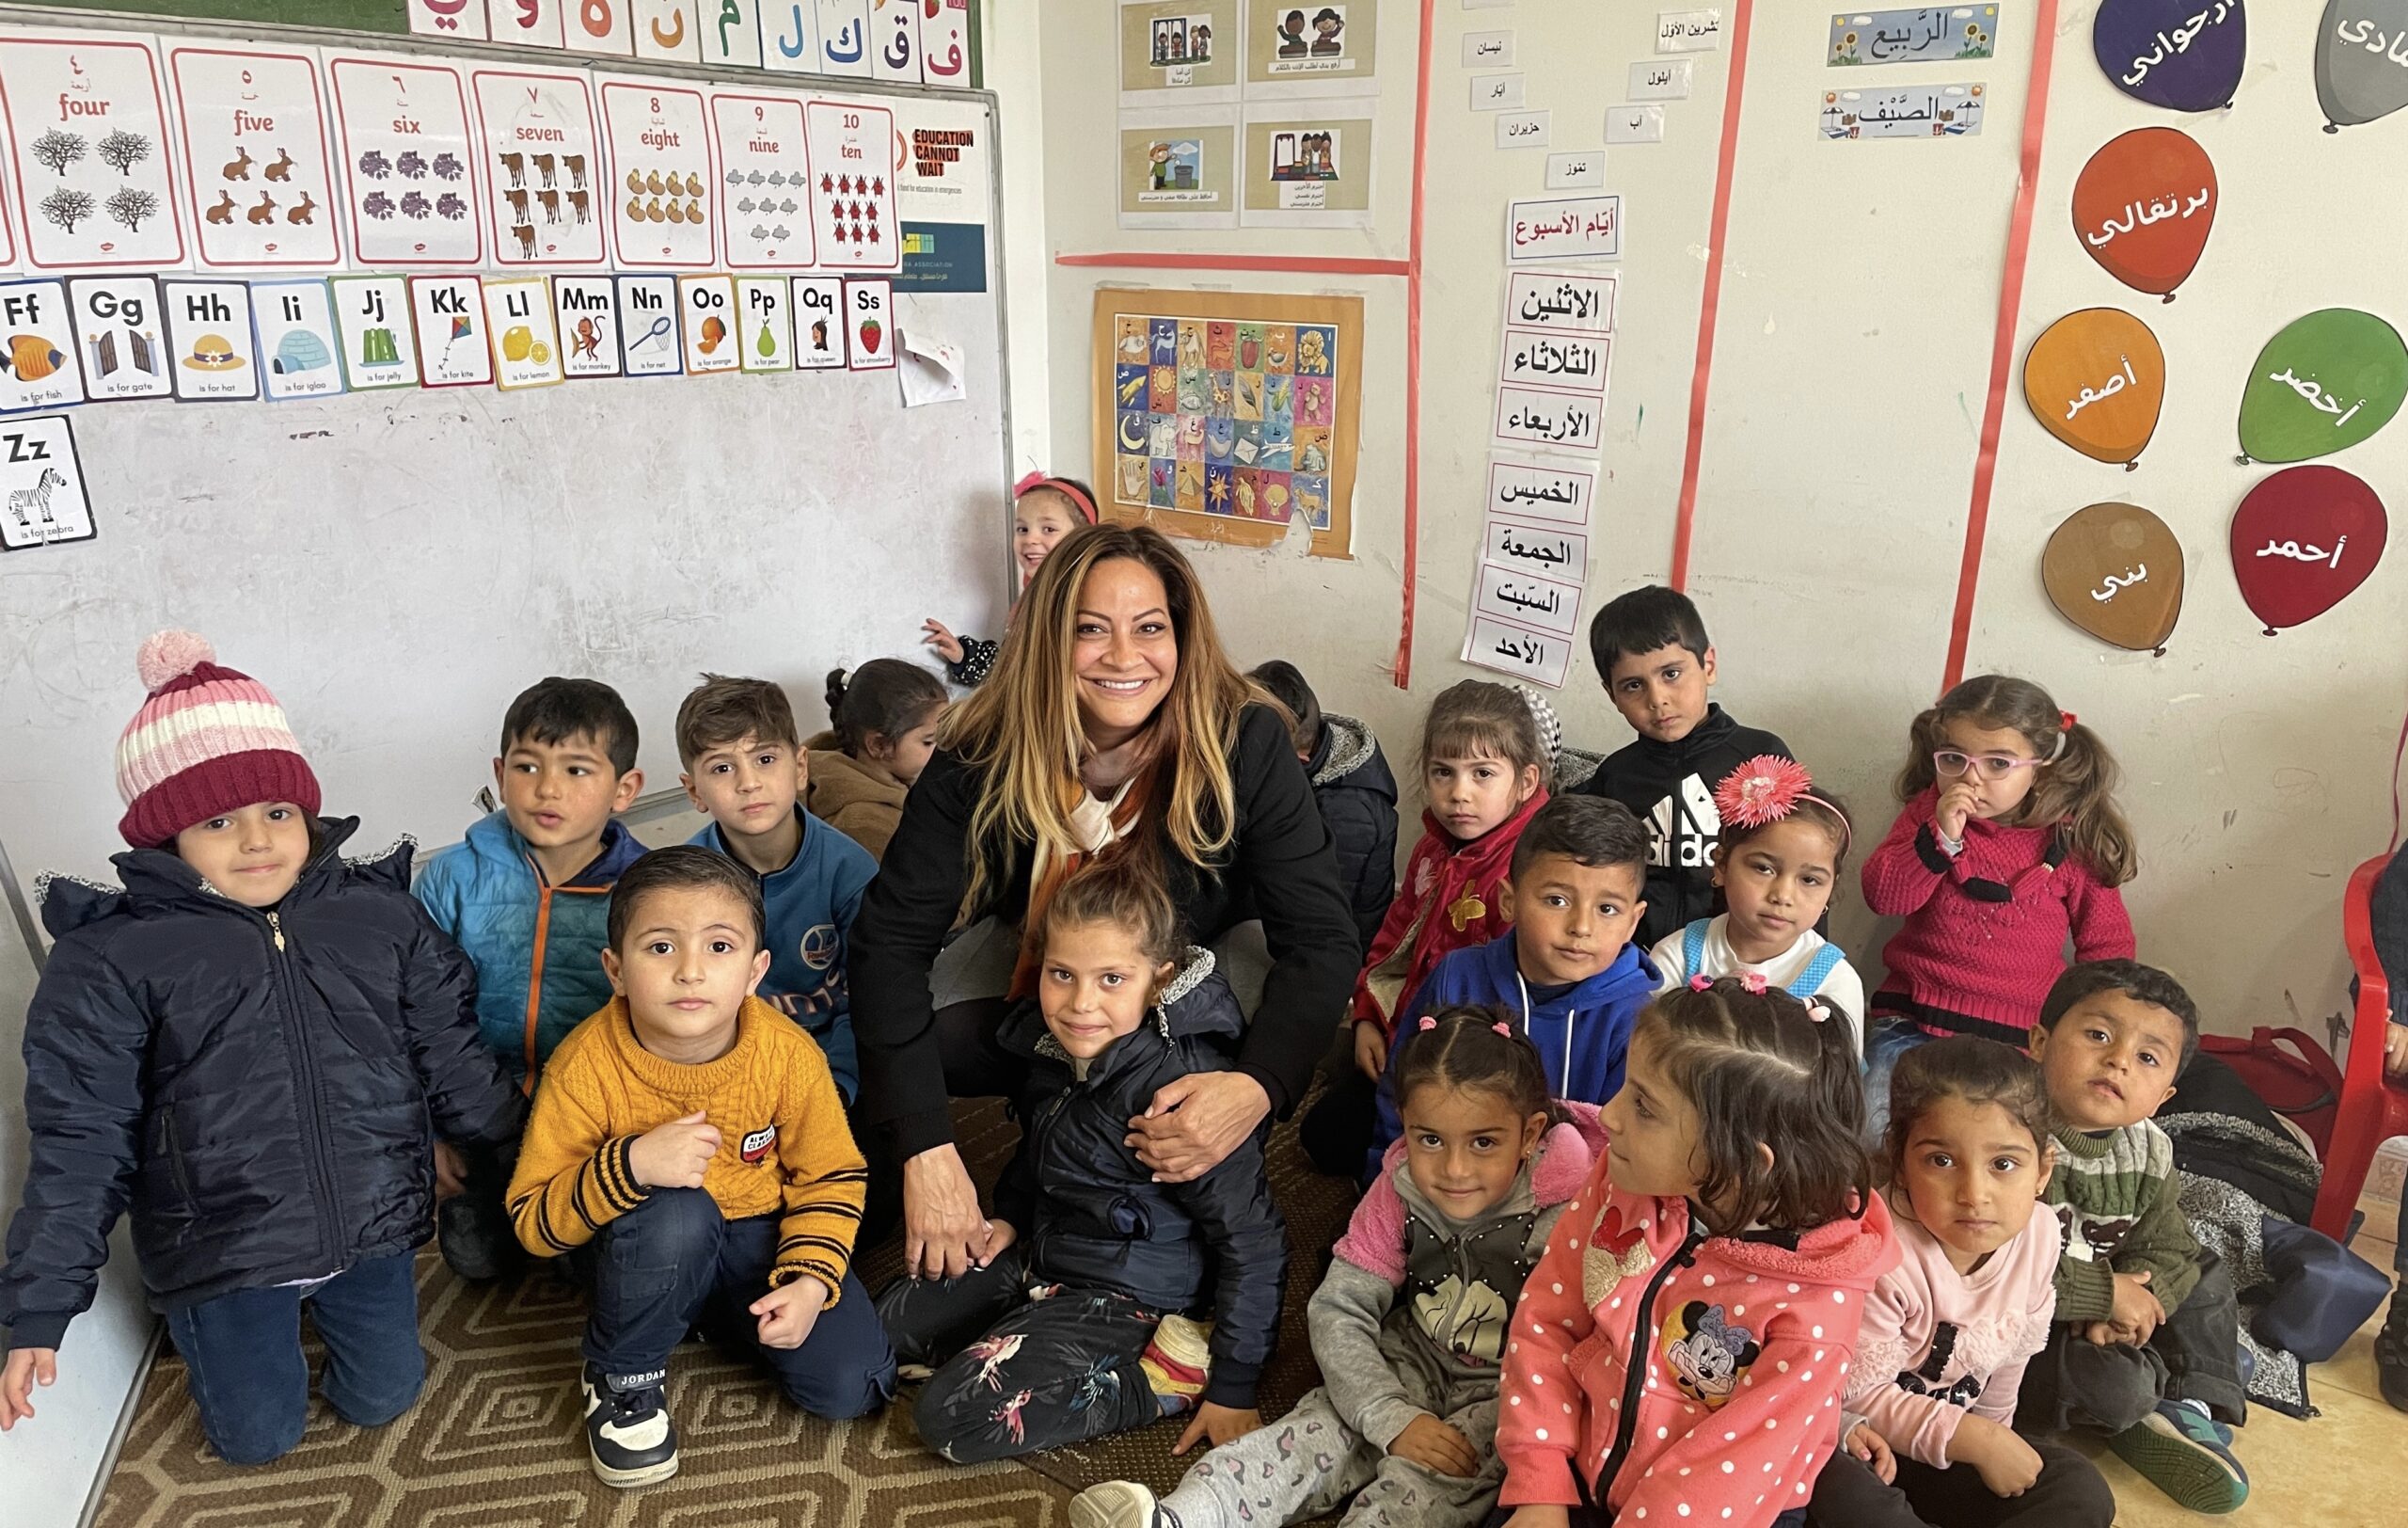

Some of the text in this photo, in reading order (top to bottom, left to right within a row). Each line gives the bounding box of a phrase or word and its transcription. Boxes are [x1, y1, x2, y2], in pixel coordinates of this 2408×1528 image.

[652, 0, 684, 48] ن
[719, 0, 741, 56] م
[780, 5, 803, 57] ل
[826, 18, 863, 63] ك
[884, 15, 910, 69] ق
[1478, 40, 1501, 55] نيسان
[928, 29, 962, 75] ف
[70, 55, 84, 75] ٤
[242, 71, 252, 84] ٥
[392, 76, 405, 93] ٦
[1648, 69, 1671, 86] أيلول
[527, 87, 538, 103] ٧
[651, 98, 660, 113] 8
[59, 93, 110, 121] four
[754, 107, 764, 121] 9
[234, 109, 274, 135] five
[392, 116, 421, 134] six
[843, 114, 860, 129] 10
[1509, 122, 1540, 135] حزيران
[516, 126, 564, 142] seven
[641, 130, 680, 151] eight
[913, 129, 974, 147] EDUCATION
[749, 138, 780, 153] nine
[841, 143, 862, 159] ten
[915, 145, 959, 162] CANNOT
[916, 162, 944, 177] WAIT
[1515, 210, 1579, 246] الأسبوع
[2087, 187, 2209, 249] برتقالي
[89, 291, 144, 326] Gg
[186, 294, 231, 322] Hh
[282, 295, 302, 321] Ii
[362, 290, 385, 323] Jj
[431, 287, 468, 314] Kk
[506, 291, 530, 317] Ll
[562, 288, 609, 310] Mm
[631, 287, 662, 310] Nn
[692, 287, 724, 309] Oo
[750, 289, 775, 316] Pp
[802, 287, 833, 314] Qq
[857, 290, 880, 310] Ss
[1521, 283, 1599, 322] الاثنين
[4, 294, 40, 326] Ff
[589, 363, 611, 372] monkey
[1513, 340, 1596, 377] الثلاثاء
[307, 380, 326, 391] igloo
[374, 373, 386, 381] for
[387, 371, 402, 382] jelly
[519, 372, 529, 380] for
[530, 371, 550, 379] lemon
[1117, 371, 1130, 379] ص
[31, 392, 43, 402] for
[46, 390, 63, 399] fish
[132, 384, 152, 393] gate
[2065, 354, 2137, 420] أصفر
[2269, 367, 2367, 427] أخضر
[1273, 427, 1281, 437] ط
[1508, 405, 1590, 440] الأربعاء
[1314, 431, 1328, 442] ض
[3, 434, 51, 463] Zz
[1210, 467, 1216, 477] ن
[1263, 473, 1269, 484] ل
[1500, 480, 1578, 506] الخميس
[21, 526, 74, 539] is for zebra
[1501, 528, 1571, 569] الجمعة
[2257, 534, 2348, 569] أحمر
[2091, 563, 2148, 605] بني
[1496, 633, 1544, 665] الأحد
[621, 1369, 666, 1385] JORDAN
